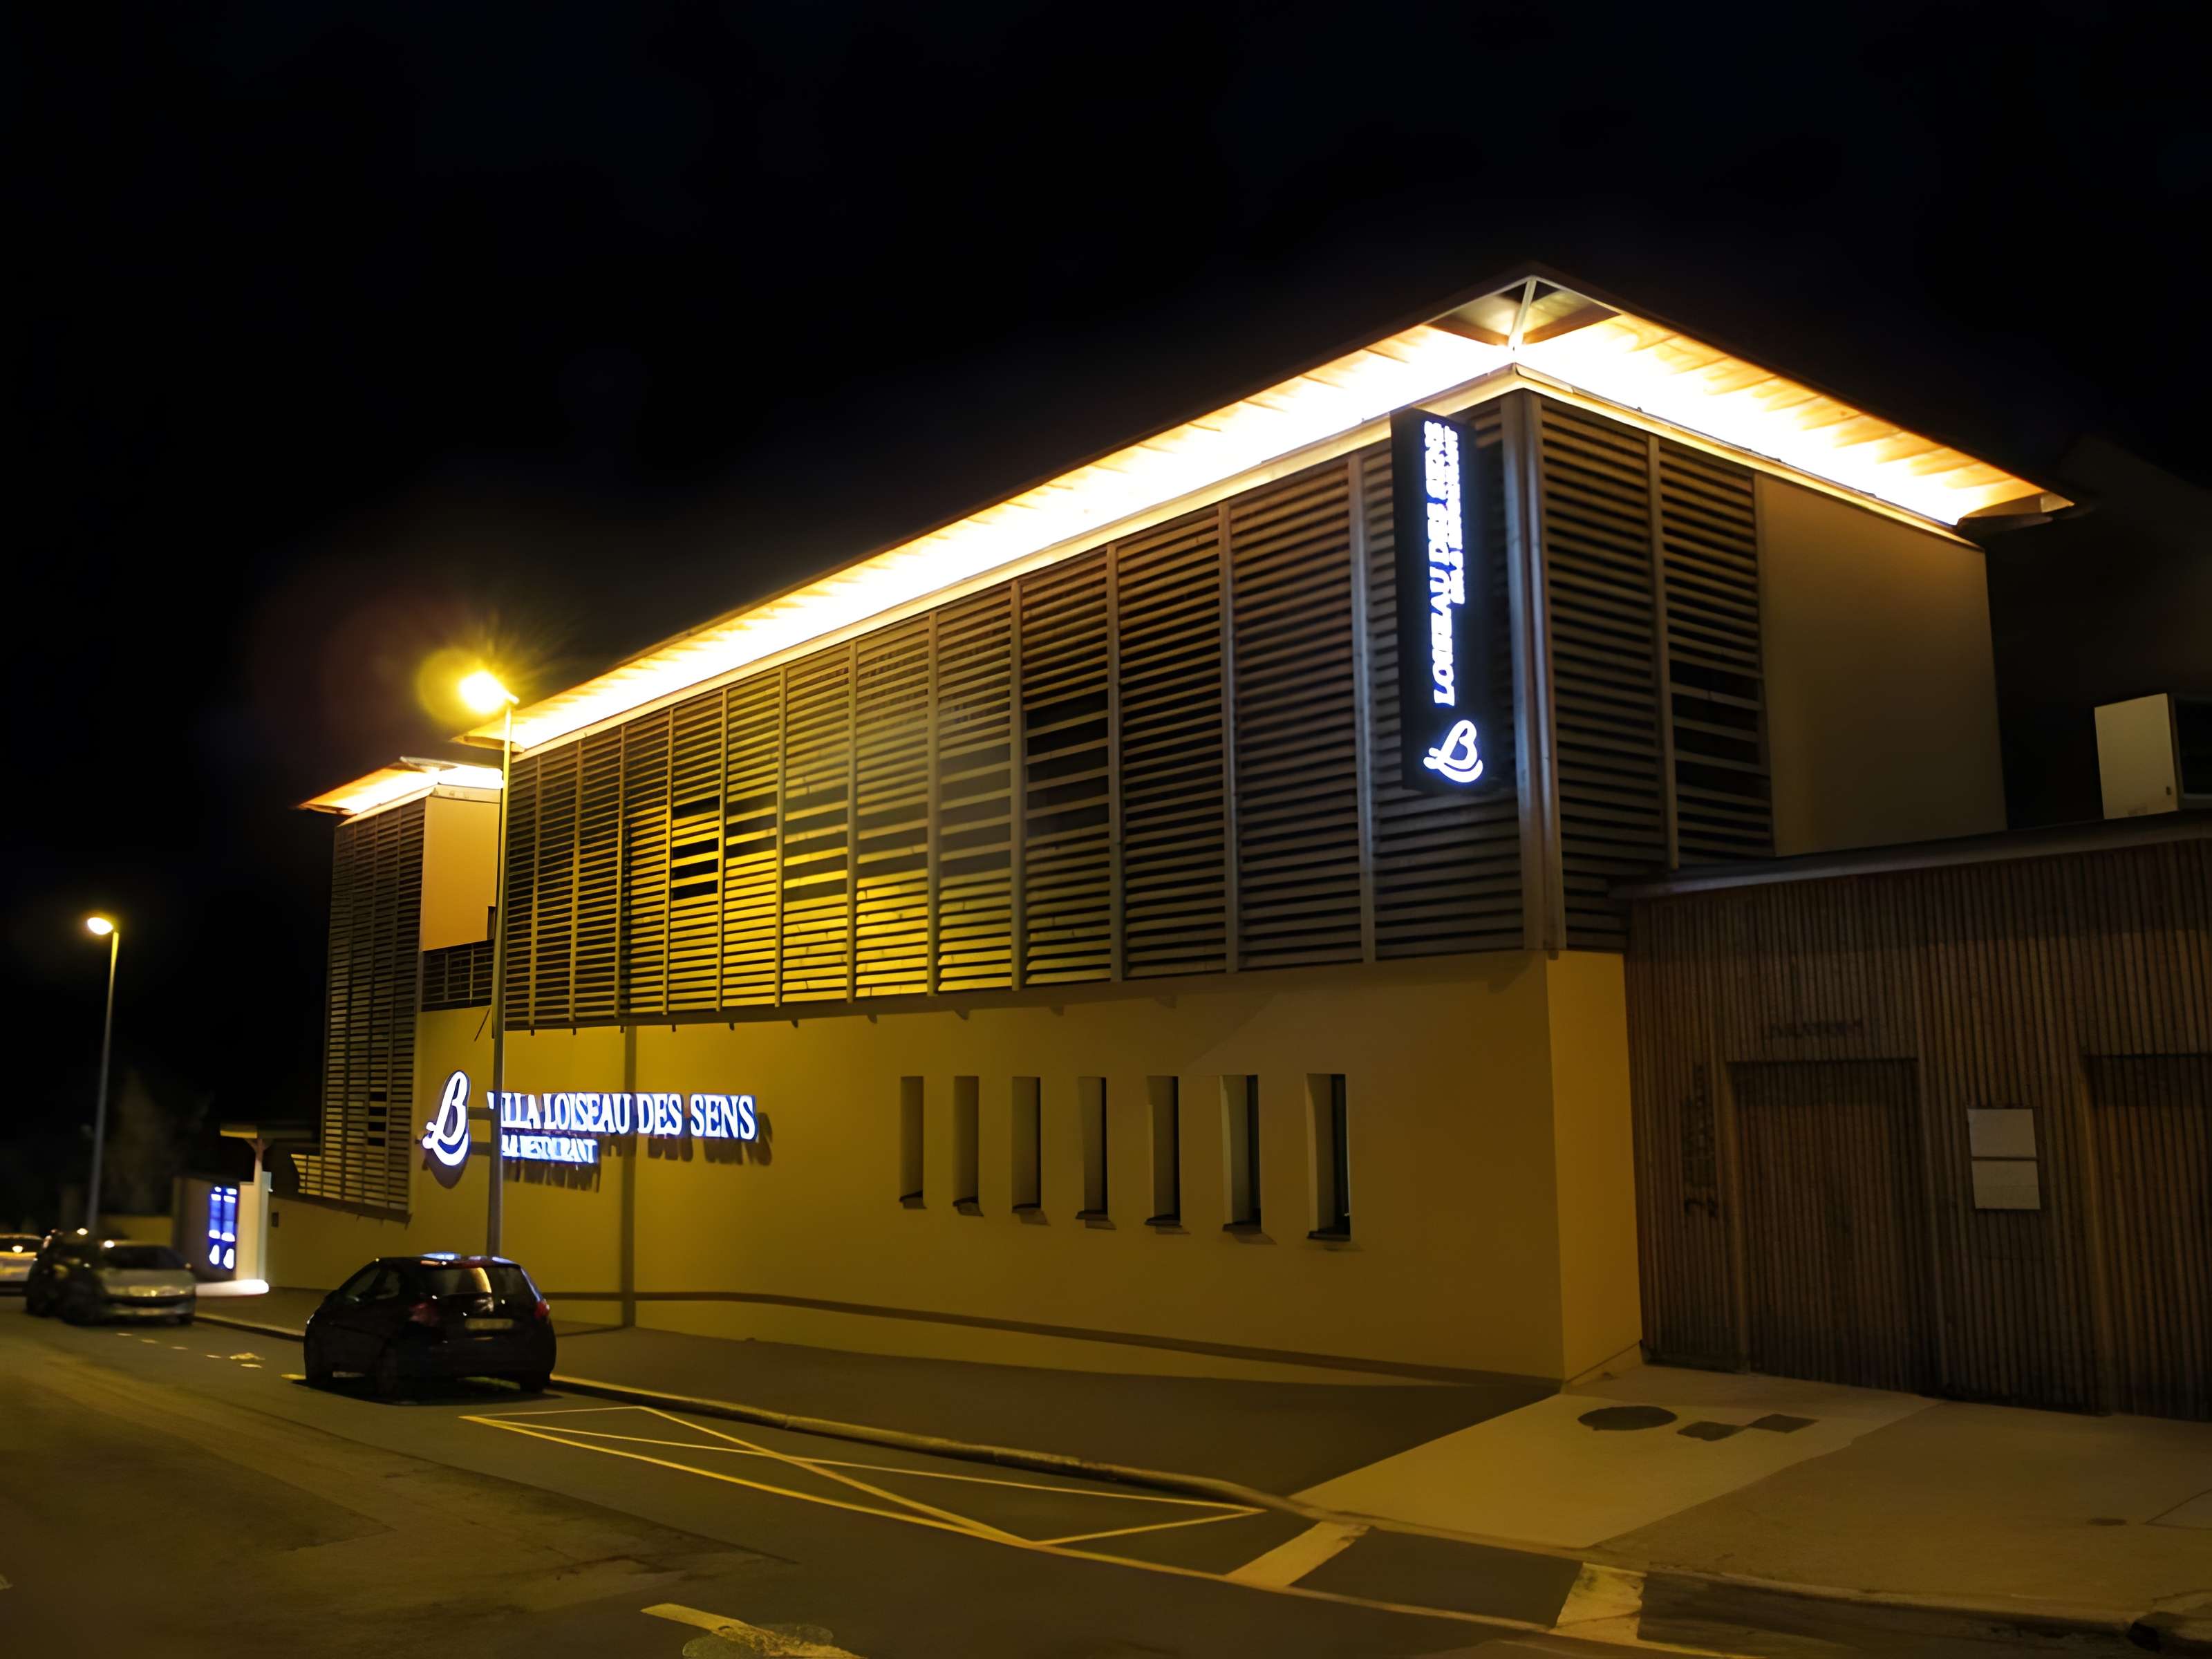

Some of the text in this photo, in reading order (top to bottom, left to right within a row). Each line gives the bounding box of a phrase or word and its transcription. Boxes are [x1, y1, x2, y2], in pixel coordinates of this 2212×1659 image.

[487, 1091, 756, 1141] LLA LOISEAU DES SENS
